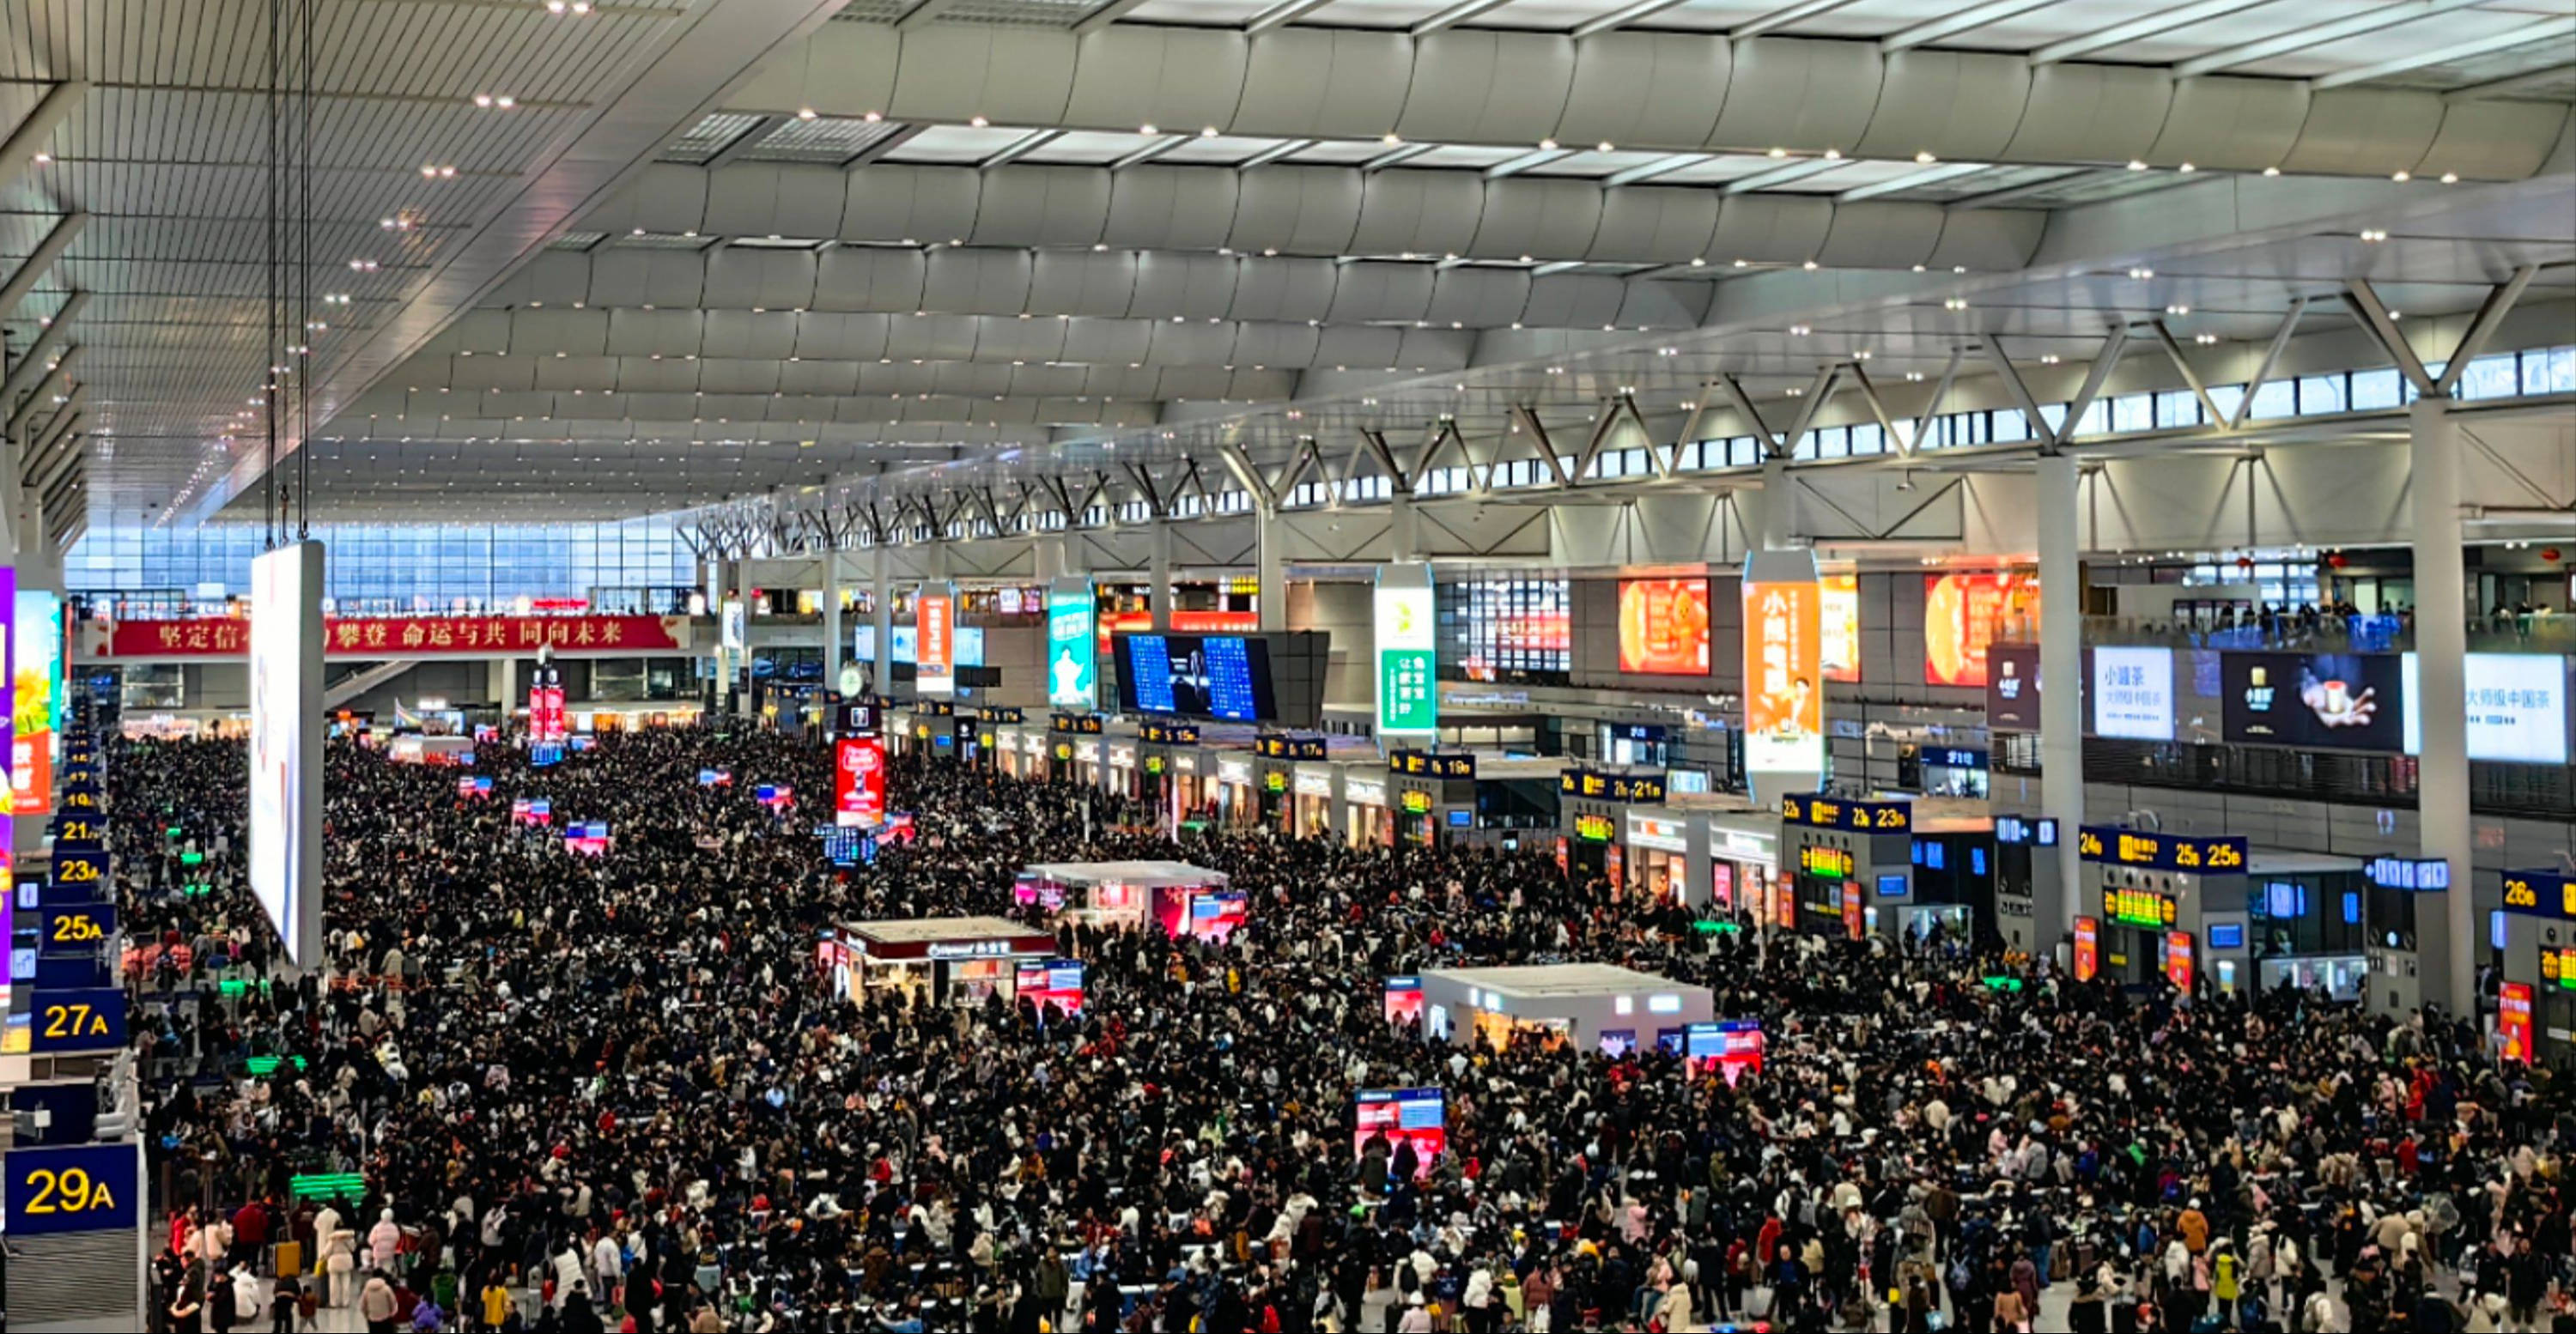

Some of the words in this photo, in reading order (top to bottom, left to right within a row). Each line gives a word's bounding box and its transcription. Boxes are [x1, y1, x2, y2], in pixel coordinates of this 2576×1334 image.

[403, 622, 507, 646] 命运与共
[519, 620, 623, 644] 同向未来
[1876, 808, 1906, 828] 23B
[2080, 833, 2102, 856] 24B
[2176, 842, 2200, 867] 25B
[2207, 844, 2241, 867] 25B
[59, 860, 100, 882] 23A
[2505, 879, 2537, 907] 26B
[53, 915, 103, 941] 25A
[45, 1004, 109, 1038] 27A
[24, 1167, 115, 1215] 29A
